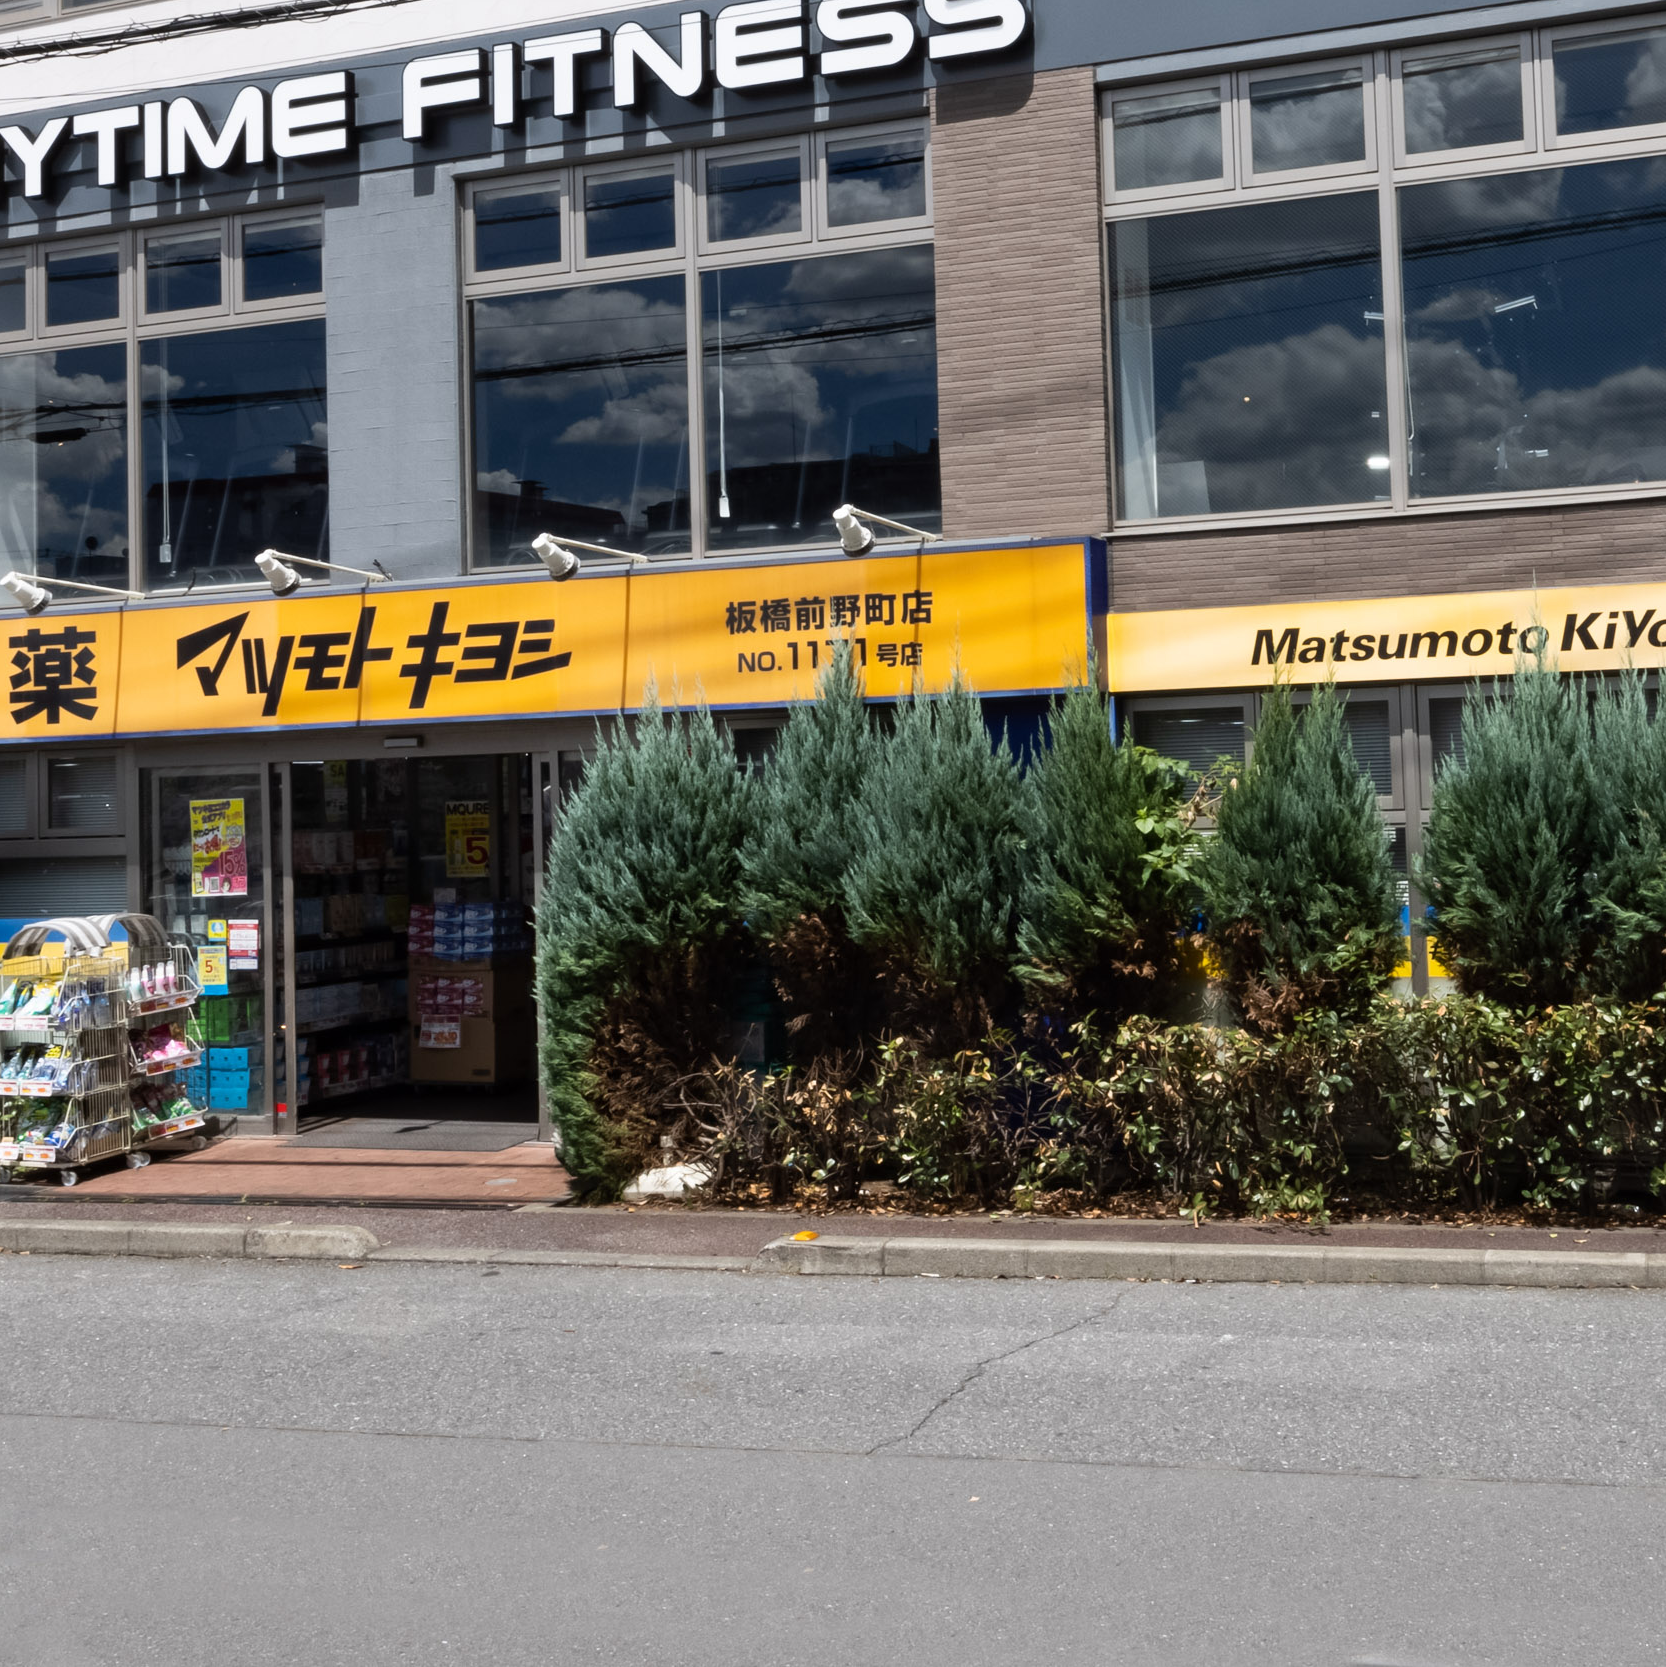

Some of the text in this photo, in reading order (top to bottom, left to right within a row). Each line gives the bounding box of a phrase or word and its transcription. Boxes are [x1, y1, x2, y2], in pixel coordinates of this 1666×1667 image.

[726, 589, 933, 635] 板橋前野町店
[1251, 616, 1549, 666] Matsumoto
[9, 626, 97, 725] 薬
[175, 601, 572, 716] マツモトキヨシ
